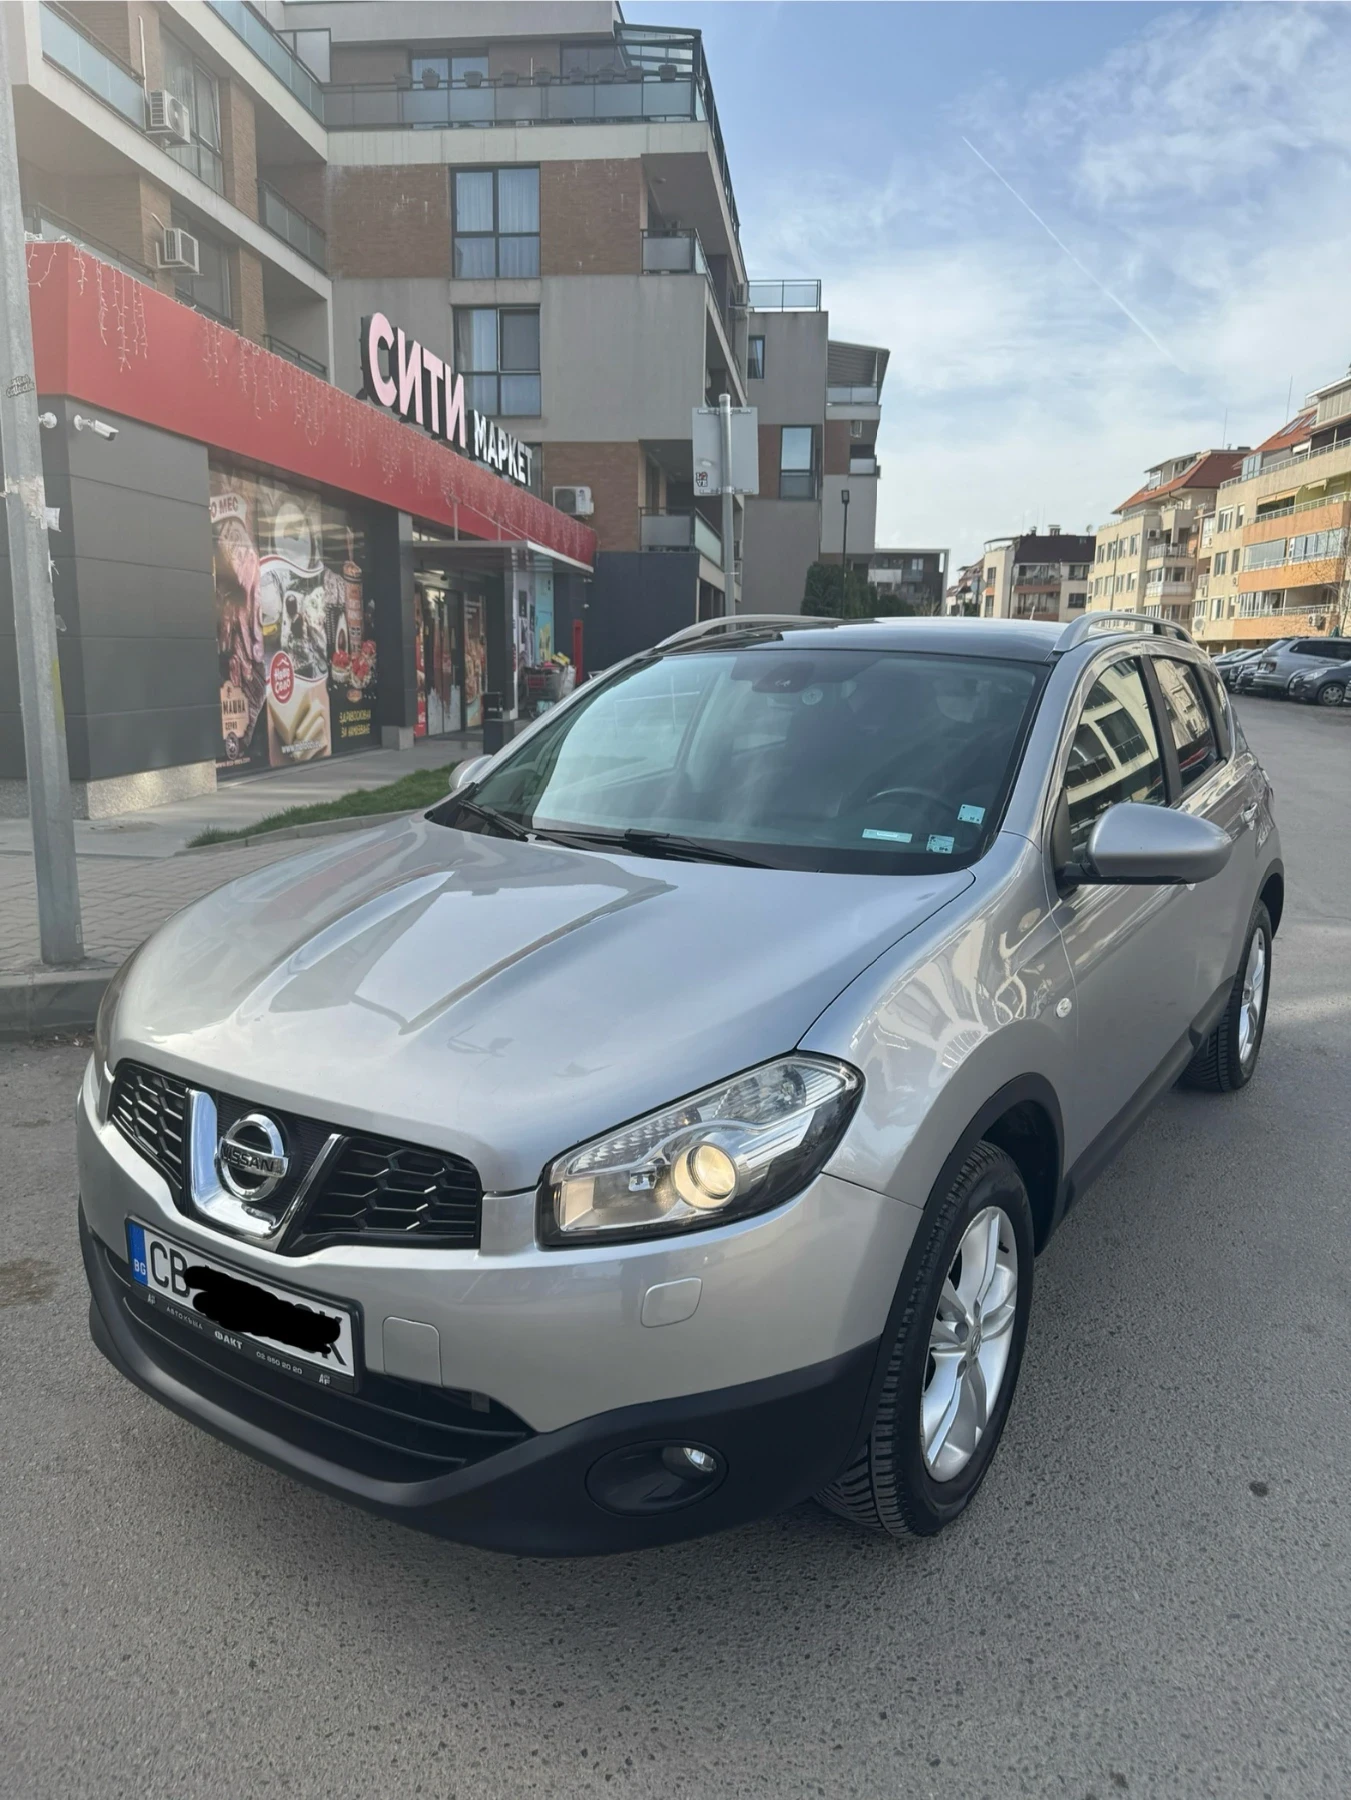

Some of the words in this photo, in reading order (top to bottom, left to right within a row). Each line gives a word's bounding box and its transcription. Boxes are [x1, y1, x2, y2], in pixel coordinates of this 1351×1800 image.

[368, 311, 466, 450] СИТИ
[473, 408, 533, 487] МАРКЕТ
[221, 1141, 275, 1172] NISSAN
[133, 1258, 147, 1276] BG
[214, 1330, 243, 1350] ФАКТ
